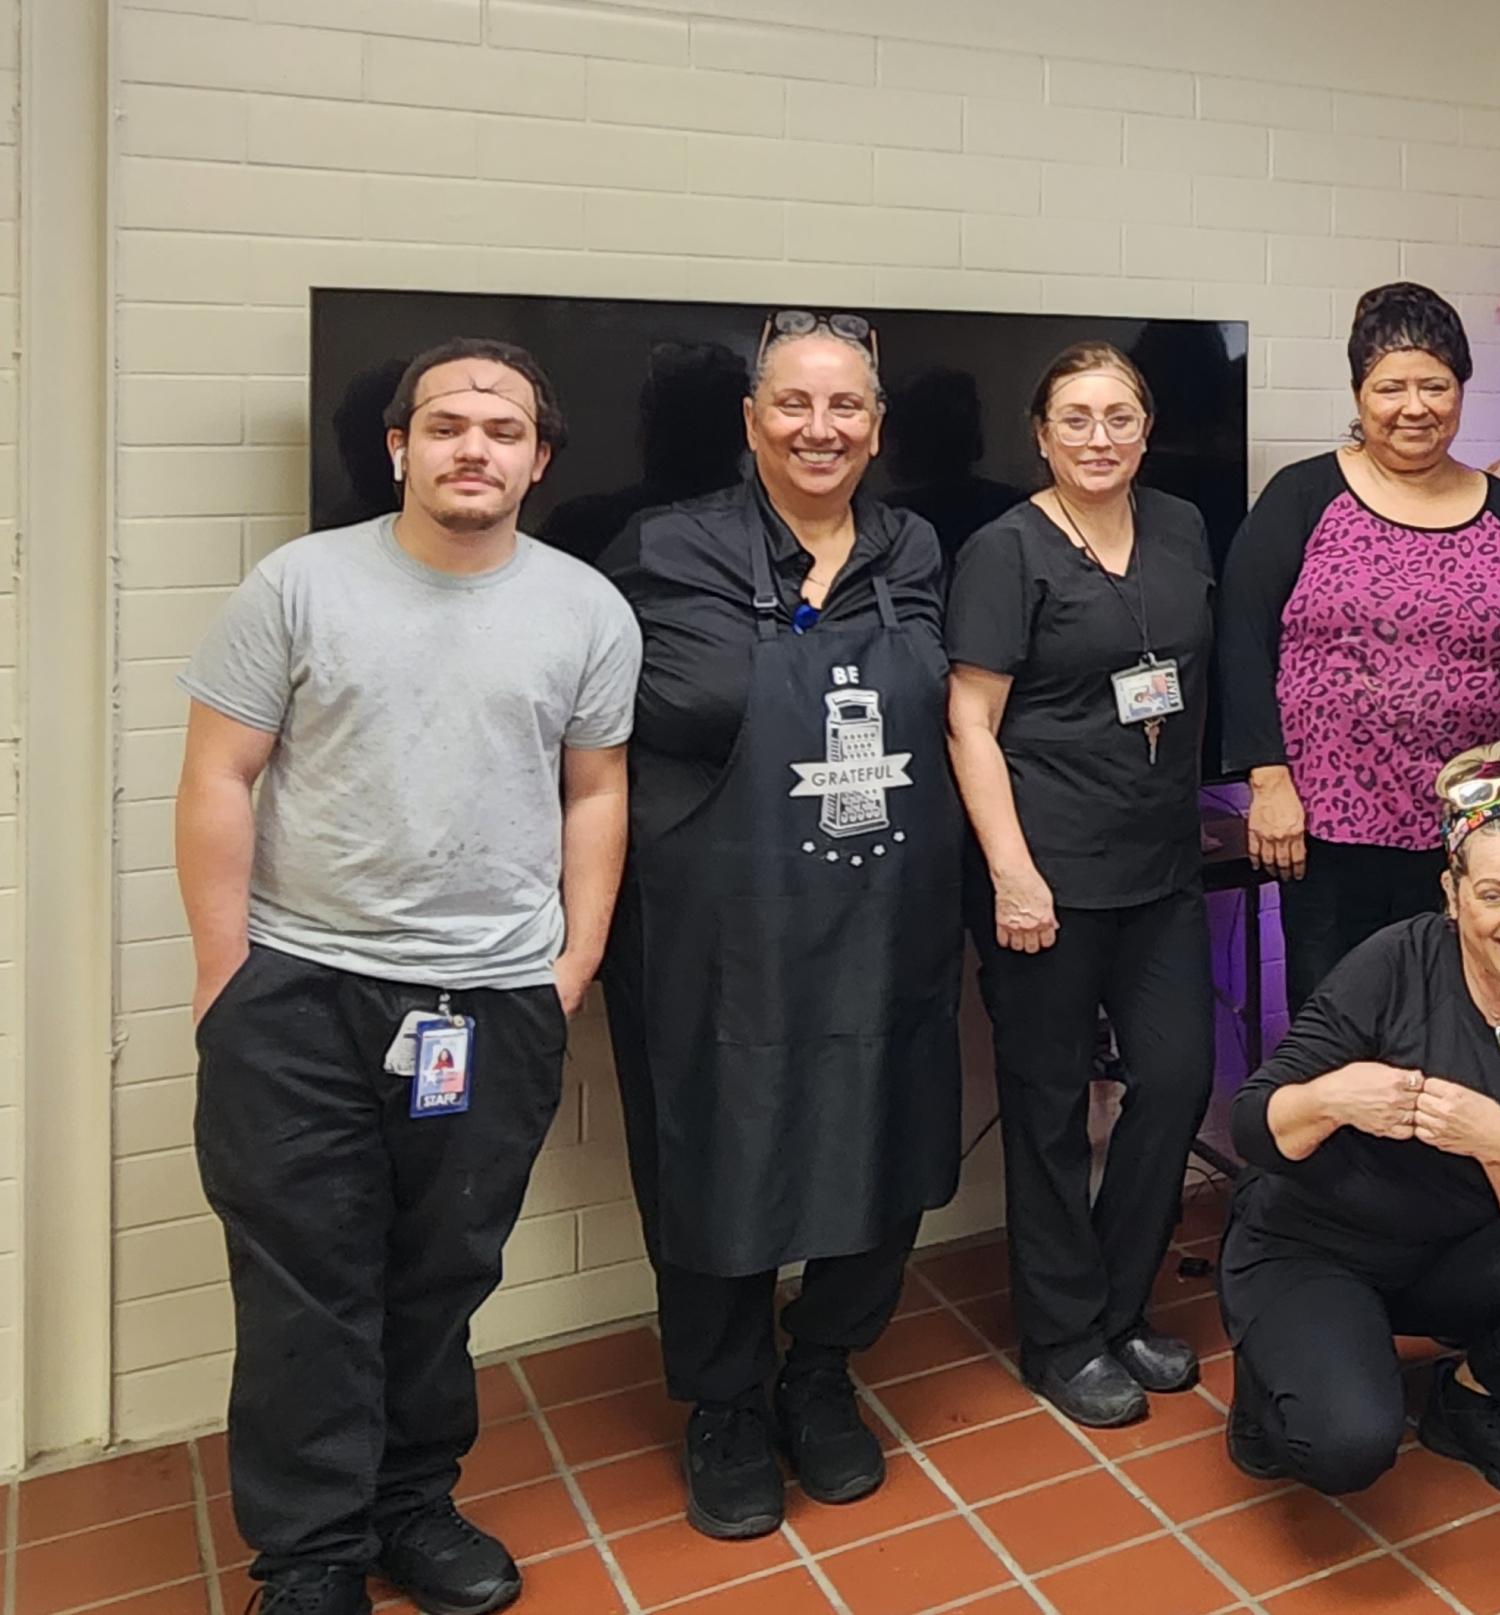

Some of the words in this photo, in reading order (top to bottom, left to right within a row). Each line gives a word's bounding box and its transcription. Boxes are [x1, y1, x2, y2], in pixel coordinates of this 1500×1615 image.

[832, 665, 860, 686] BE
[811, 764, 894, 788] GRATEFUL
[423, 1092, 457, 1108] STAFF
